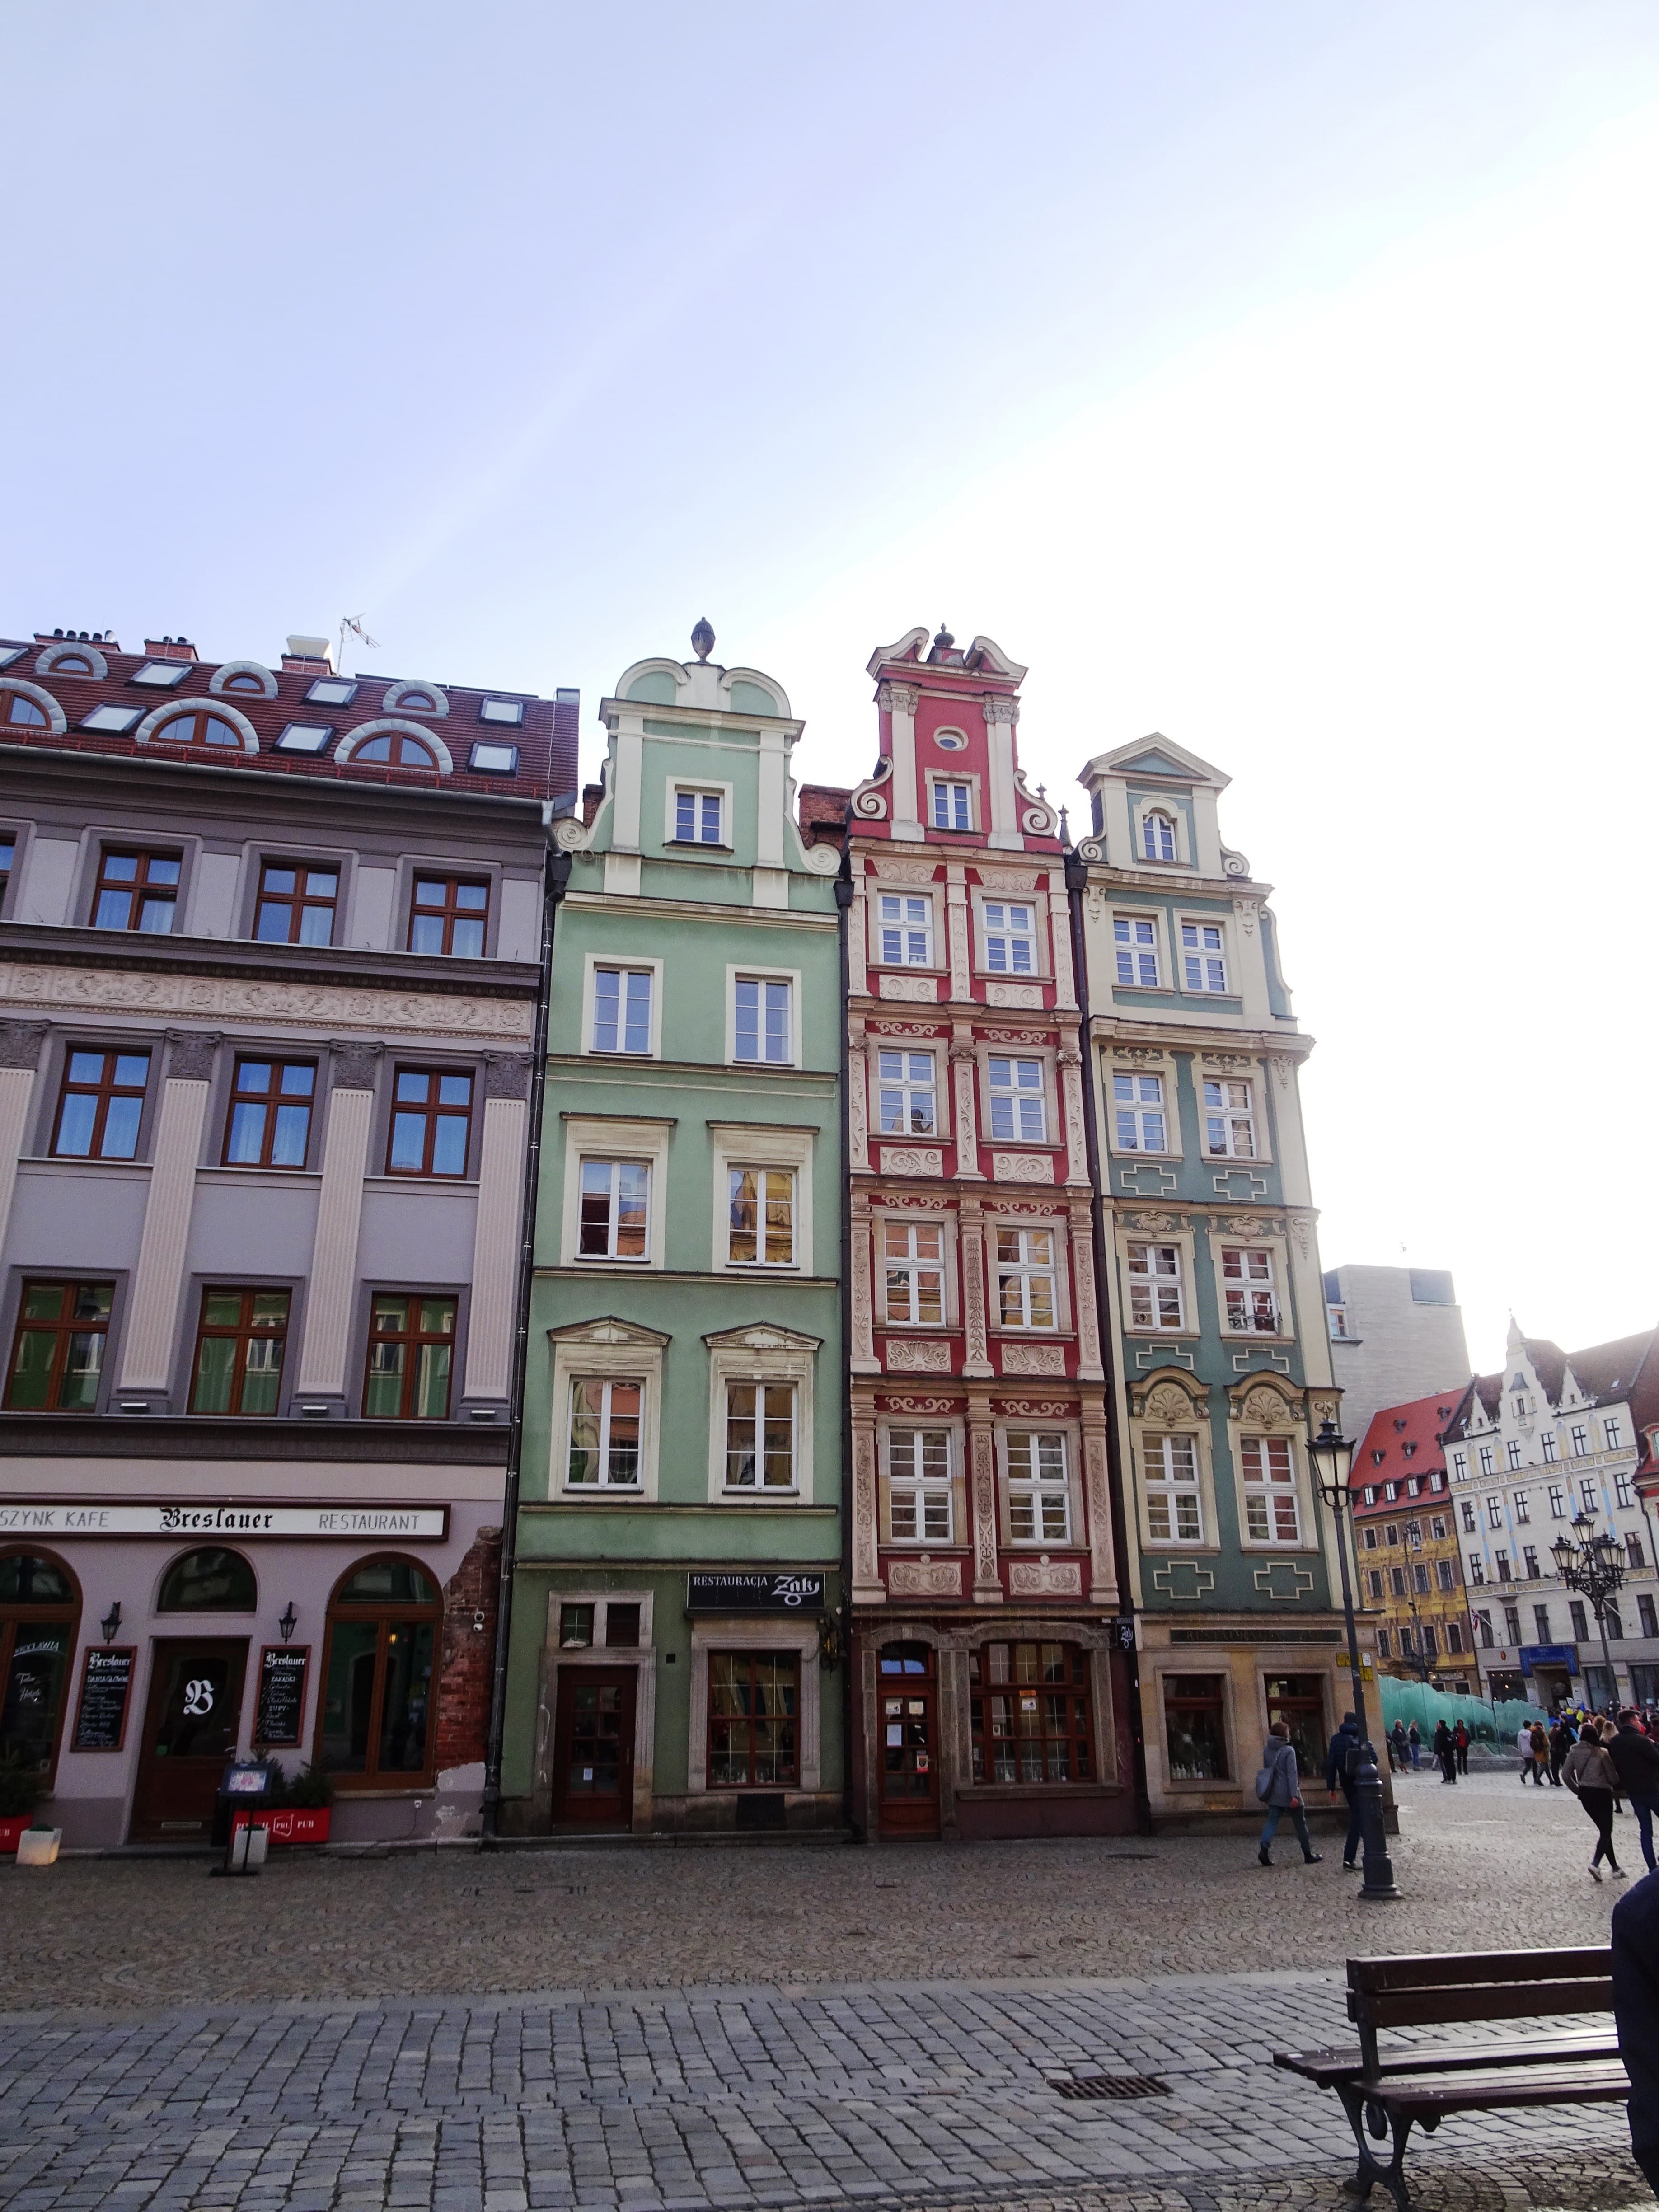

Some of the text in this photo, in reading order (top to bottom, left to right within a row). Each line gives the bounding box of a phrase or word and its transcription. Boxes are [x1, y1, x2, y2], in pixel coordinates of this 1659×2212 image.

[0, 1510, 110, 1527] SZYNK KAFE
[159, 1507, 274, 1532] Breslauer
[319, 1513, 420, 1529] RESTAURANT
[693, 1576, 768, 1587] RESTAURACJA
[87, 1652, 131, 1669] Breslauer
[263, 1651, 306, 1668] Breslauer
[183, 1679, 214, 1715] B
[297, 1820, 314, 1829] PUB
